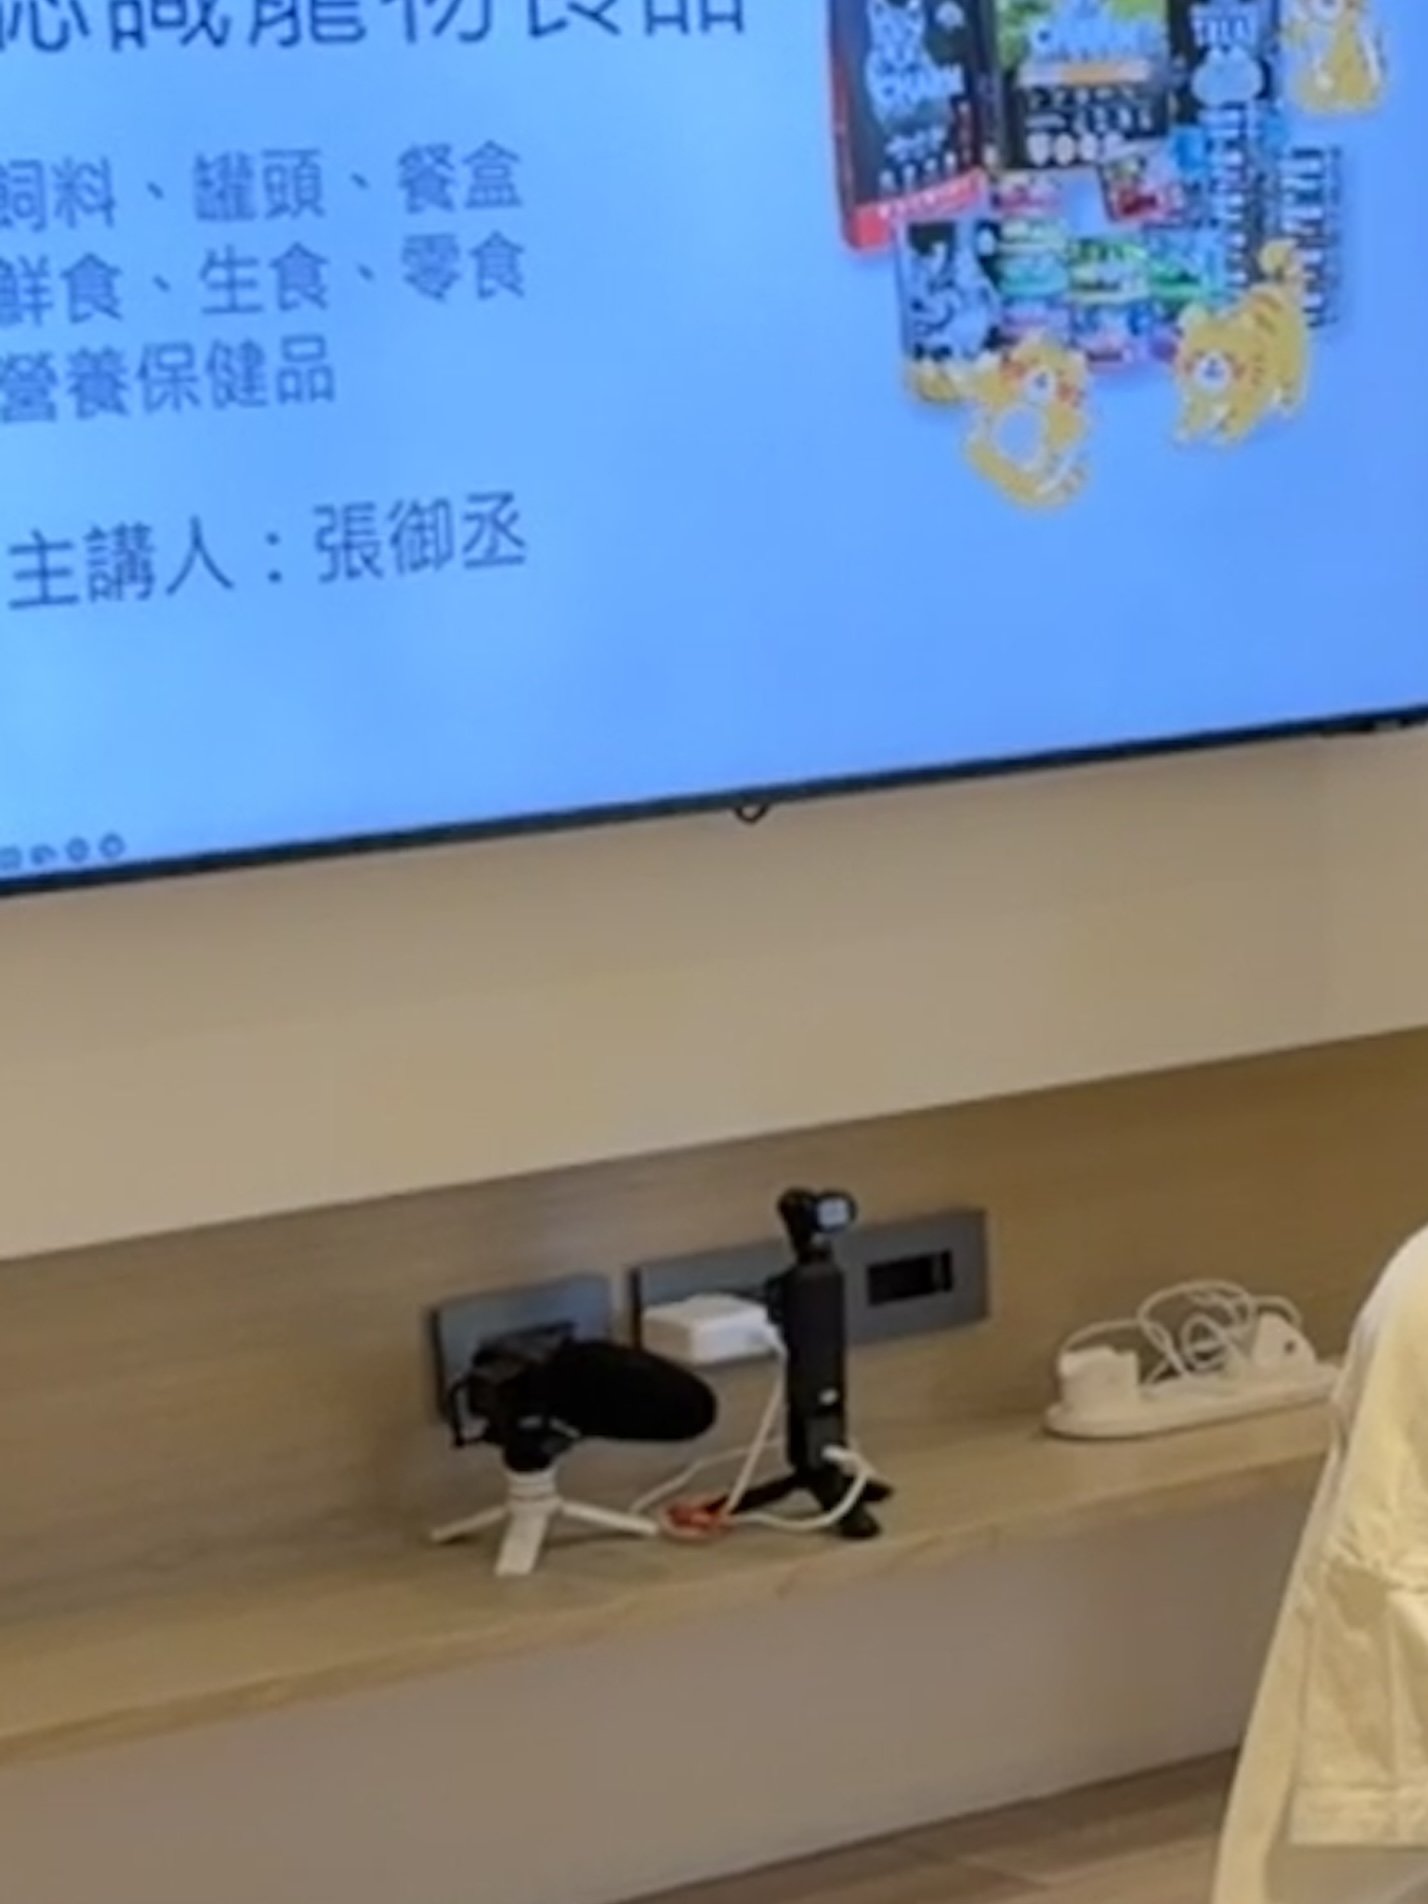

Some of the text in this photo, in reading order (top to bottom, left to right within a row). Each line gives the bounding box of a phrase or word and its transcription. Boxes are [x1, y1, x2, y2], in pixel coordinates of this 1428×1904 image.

[0, 334, 336, 425] 營養保健品
[7, 491, 527, 611] 主講人：張御丞
